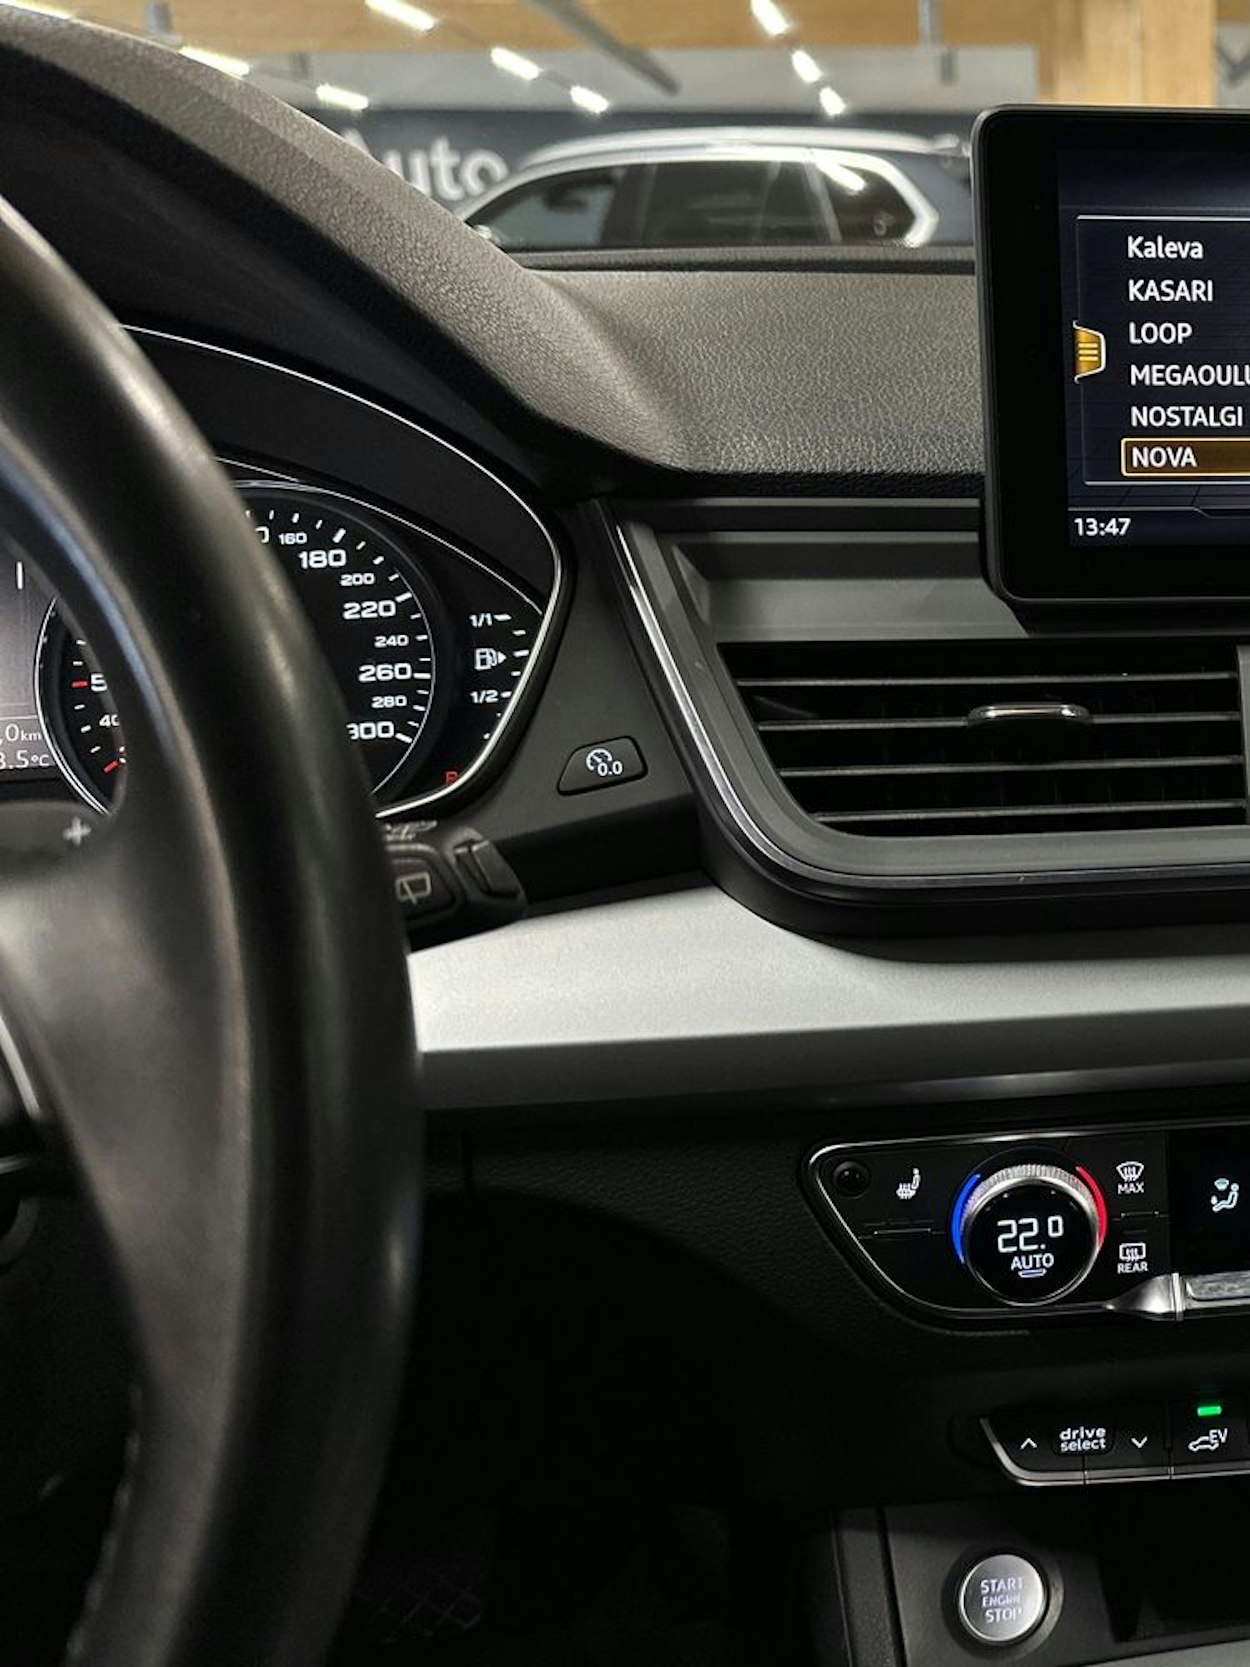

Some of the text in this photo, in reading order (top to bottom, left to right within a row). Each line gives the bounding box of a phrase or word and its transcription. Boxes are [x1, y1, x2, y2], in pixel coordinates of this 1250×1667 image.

[1127, 235, 1204, 259] Kaleva
[1128, 279, 1214, 302] KASARI
[1129, 322, 1193, 345] LOOP
[1131, 406, 1243, 427] NOSTALGI
[1132, 447, 1198, 468] NOVA
[1074, 518, 1132, 537] 13:47
[278, 531, 308, 545] 160
[298, 549, 347, 569] 180
[340, 573, 375, 587] 200
[343, 600, 397, 620] 220
[469, 612, 493, 628] 1/1
[374, 634, 409, 648] 240
[358, 663, 412, 682] 260
[371, 695, 408, 709] 280
[470, 690, 499, 703] 1/2
[346, 721, 395, 740] 300
[597, 760, 623, 777] 0.0
[1117, 1182, 1145, 1195] MAX
[1010, 1253, 1055, 1271] AUTO
[1117, 1261, 1148, 1274] REAR
[1059, 1426, 1107, 1441] drive
[1060, 1438, 1107, 1453] select
[980, 1576, 1025, 1595] START
[985, 1606, 1023, 1624] STOP
